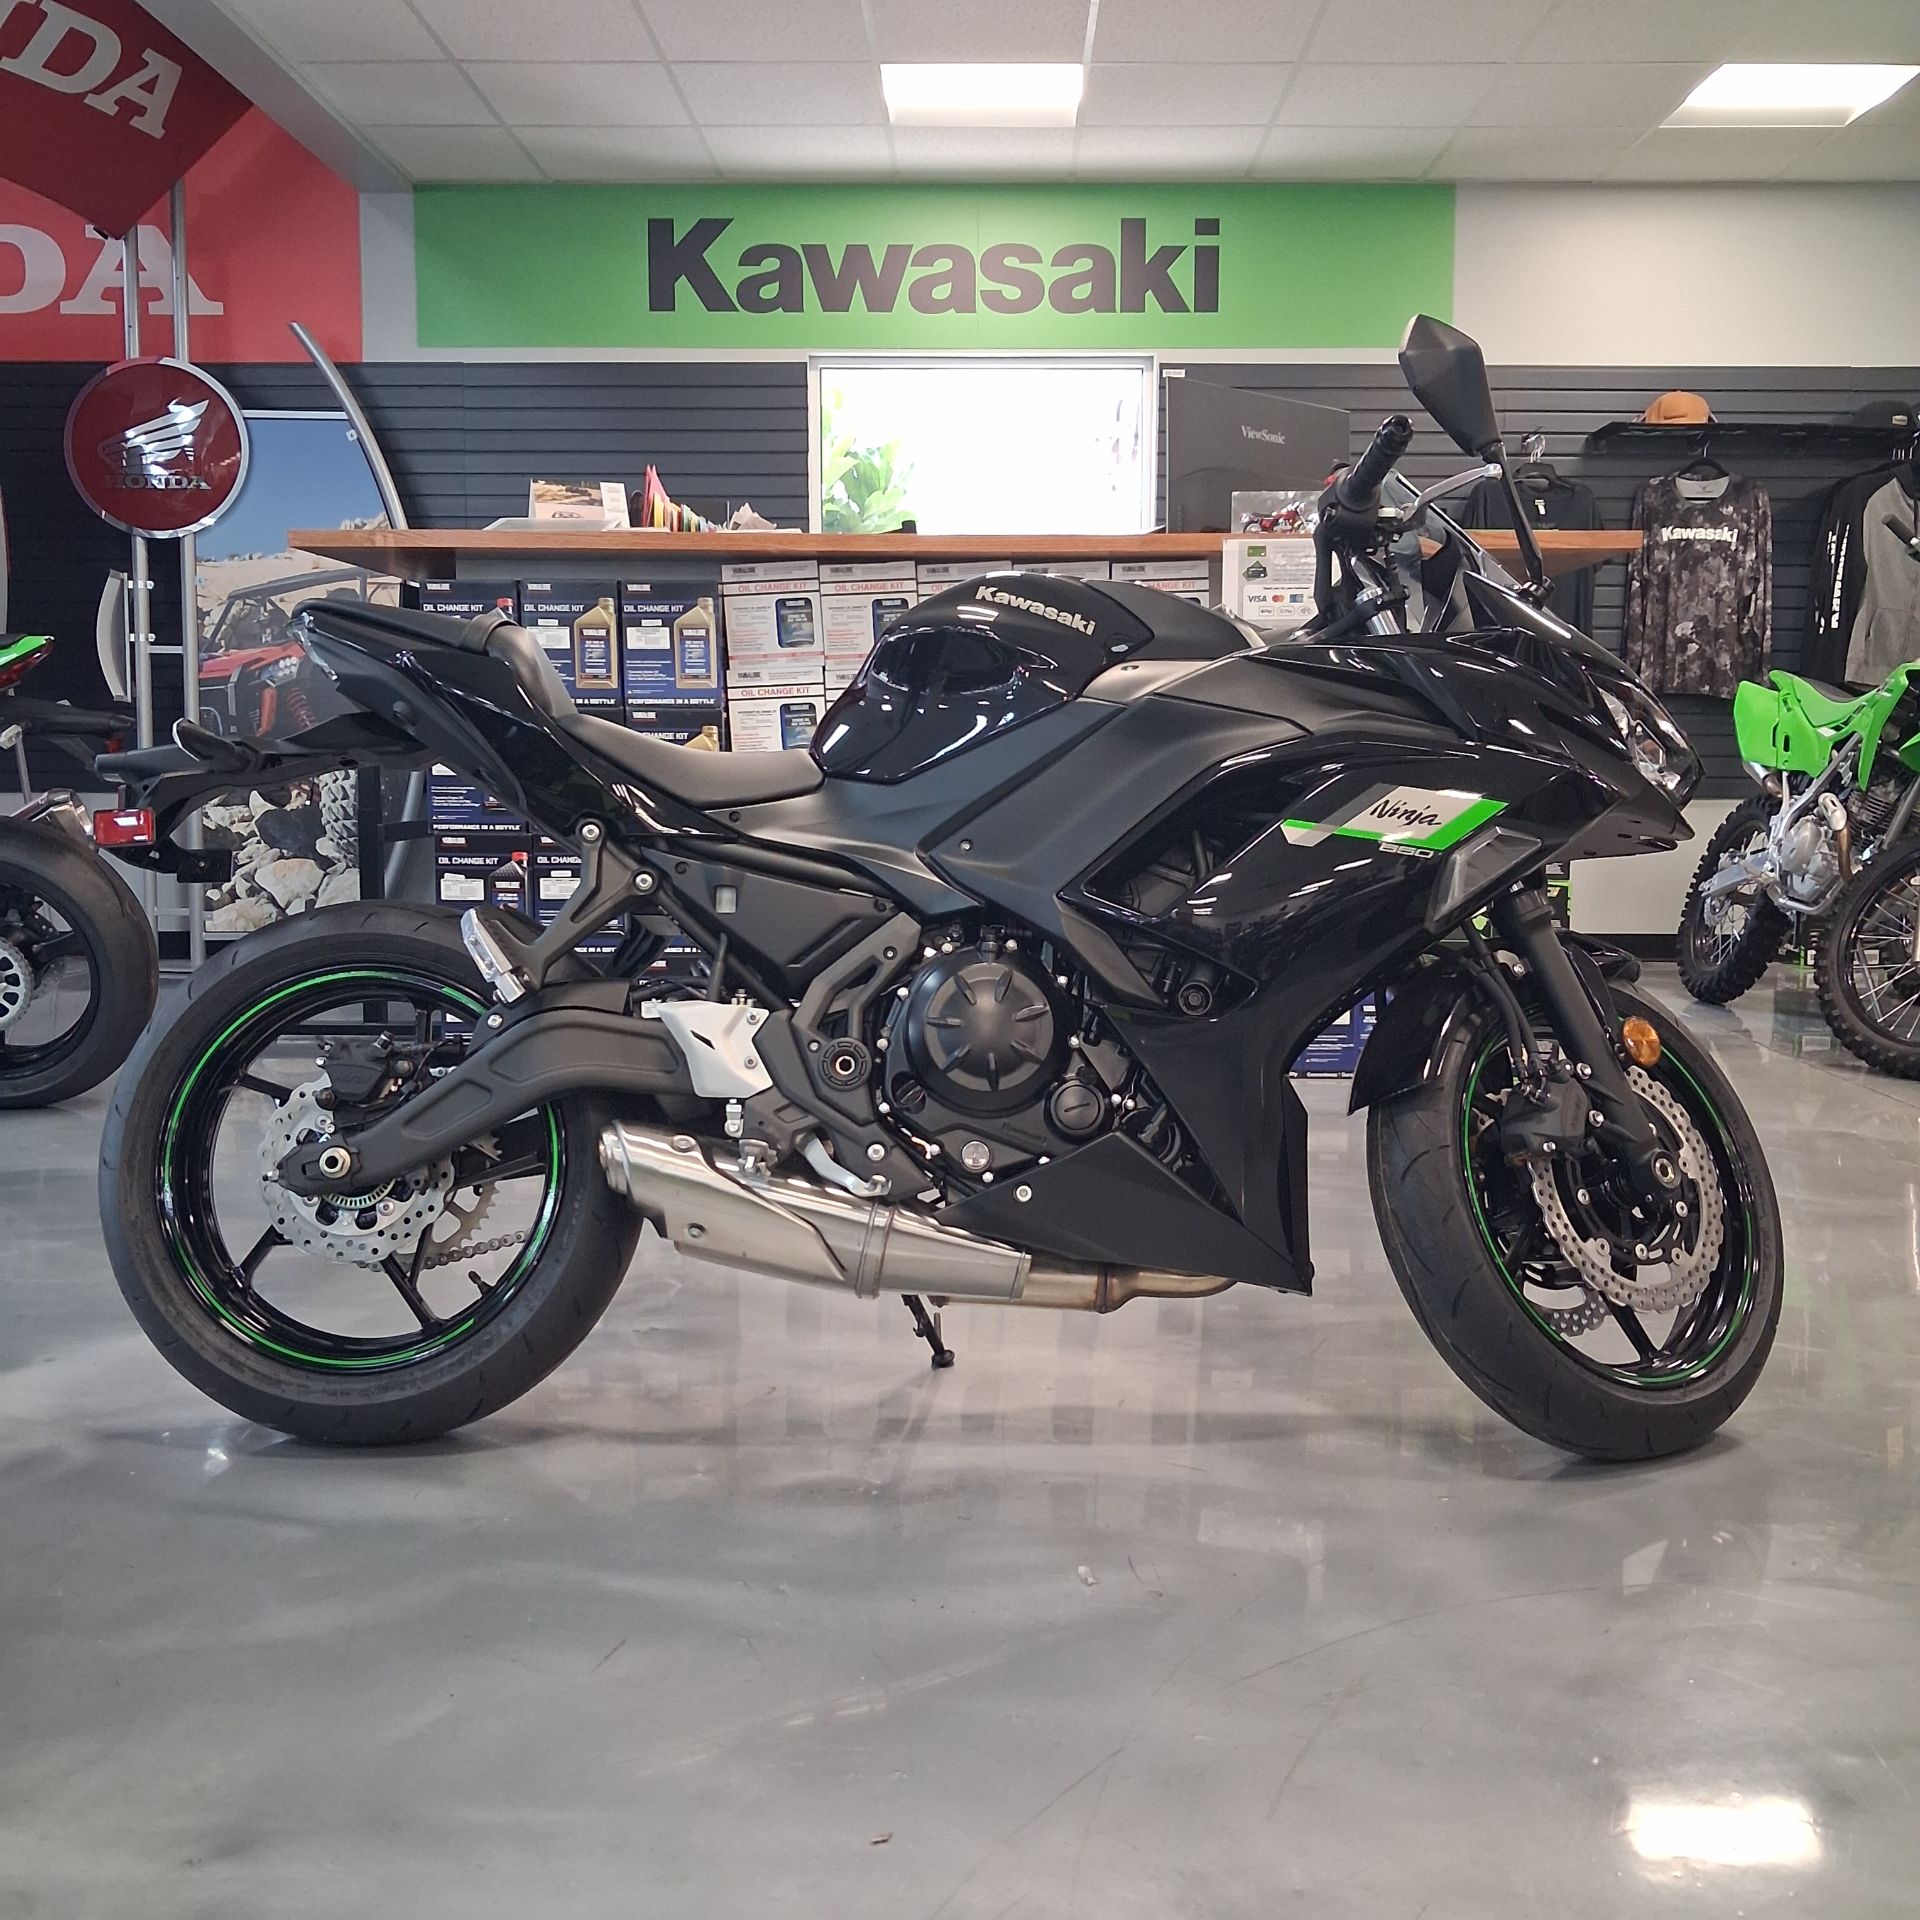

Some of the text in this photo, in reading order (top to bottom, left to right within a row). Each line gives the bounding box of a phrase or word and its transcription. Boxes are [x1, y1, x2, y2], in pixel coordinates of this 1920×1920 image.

[0, 0, 183, 139] DA
[647, 217, 1220, 314] Kawasaki
[1241, 425, 1286, 445] ViewSonic
[1661, 526, 1739, 543] Kawasaki
[738, 581, 807, 593] OIL CHANGE KIT
[834, 581, 904, 593] OIL CHANGE KIT
[1151, 581, 1196, 590] HANGE KIT
[1247, 595, 1268, 603] VISA
[422, 604, 484, 612] OIL CHANGE KIT
[523, 604, 585, 612] OIL CHANGE KIT
[623, 604, 684, 613] OIL CHANGE KIT
[974, 585, 1096, 637] Kawasaki
[741, 686, 811, 697] OIL CHANGE KIT
[675, 732, 689, 740] KIT
[1369, 799, 1442, 826] Ninja
[1379, 842, 1434, 858] 650
[438, 857, 499, 865] OIL CHANGE KIT
[537, 856, 550, 864] OIL
